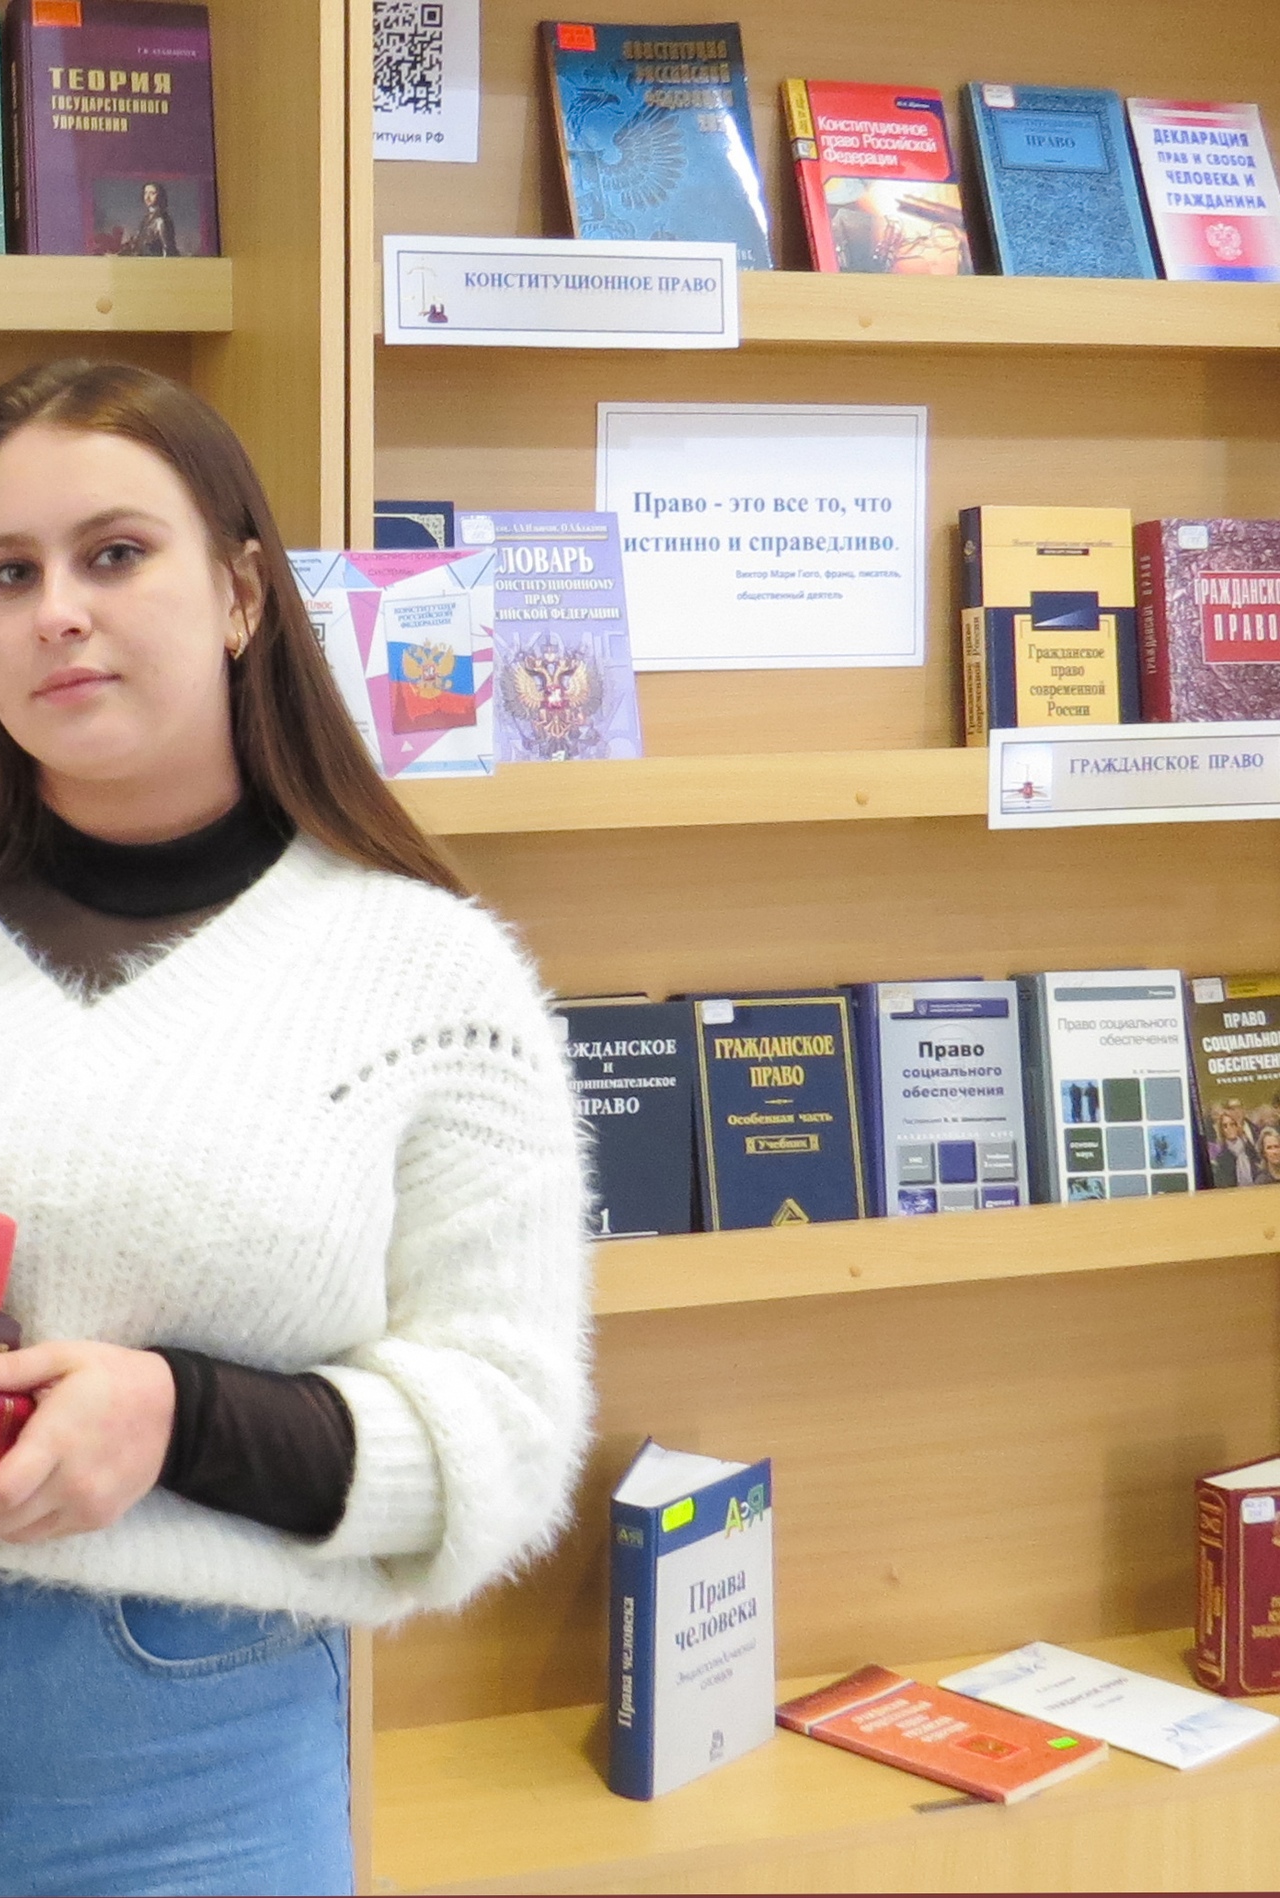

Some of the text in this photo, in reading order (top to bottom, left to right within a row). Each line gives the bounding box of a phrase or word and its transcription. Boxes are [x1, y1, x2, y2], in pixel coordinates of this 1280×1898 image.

[49, 66, 172, 95] ТЕОРИЯ
[51, 94, 169, 115] ГОСУДАРСТВЕННОГО
[52, 114, 129, 133] УПРАВЛЕНИЯ
[818, 116, 929, 136] Конституционное
[373, 131, 445, 144] титуция РФ
[821, 133, 938, 153] право Российской
[1025, 134, 1076, 149] ПРАВО
[1153, 127, 1249, 148] ДЕКЛАРАЦИЯ
[823, 149, 899, 167] Федерации
[1158, 151, 1257, 169] ПРАВ И СВОБОД
[1166, 169, 1256, 187] ЧЕЛОВЕКА И
[1166, 191, 1267, 210] ГРАЖДАНИНА
[464, 271, 717, 293] КОНСТИТУЦИОННОЕ ПРАВО
[633, 491, 707, 518] Право
[729, 497, 766, 513] это
[773, 498, 809, 513] все
[817, 498, 847, 517] то,
[853, 498, 893, 513] что
[624, 535, 900, 557] истинно и справедливо.
[495, 546, 595, 574] ЛОВАРЬ
[735, 569, 769, 580] Виктор
[770, 570, 796, 579] Мари
[495, 579, 615, 592] ОНСТИТУЦИОННОМУ
[1194, 578, 1280, 609] ГРАЖДАНСКО
[524, 594, 562, 605] ПРАВУ
[736, 590, 844, 601] общественный деятель
[551, 607, 621, 620] ФЕДЕРАЦИИ
[1213, 613, 1278, 641] ПРАВО
[1144, 604, 1157, 675] ГРАЖДАНСКОЕ
[1028, 643, 1105, 662] Гражданское
[1051, 665, 1085, 679] право
[1029, 681, 1106, 697] современной
[1047, 701, 1091, 717] России
[1070, 753, 1264, 774] ГРАЖДАНСКОЕ ПРАВО
[1058, 1017, 1178, 1033] Право социального
[1223, 1010, 1267, 1029] ПРАВО
[714, 1035, 835, 1062] ГРАЖДАНСКОЕ
[1099, 1033, 1179, 1046] обеспечения
[1202, 1030, 1280, 1053] СОЦИАЛЬНО
[567, 1039, 677, 1061] ЖДАНСКОЕ
[918, 1041, 985, 1062] Право
[902, 1065, 1002, 1080] социального
[1208, 1053, 1280, 1075] ОБЕСПЕЧЕН
[569, 1076, 677, 1093] принимательское
[749, 1065, 805, 1088] ПРАВО
[902, 1084, 1005, 1099] обеспечения
[727, 1112, 795, 1126] Особенная
[600, 1208, 611, 1234] 1
[688, 1570, 747, 1615] Права
[674, 1597, 758, 1653] человека
[618, 1595, 636, 1729] Права человека
